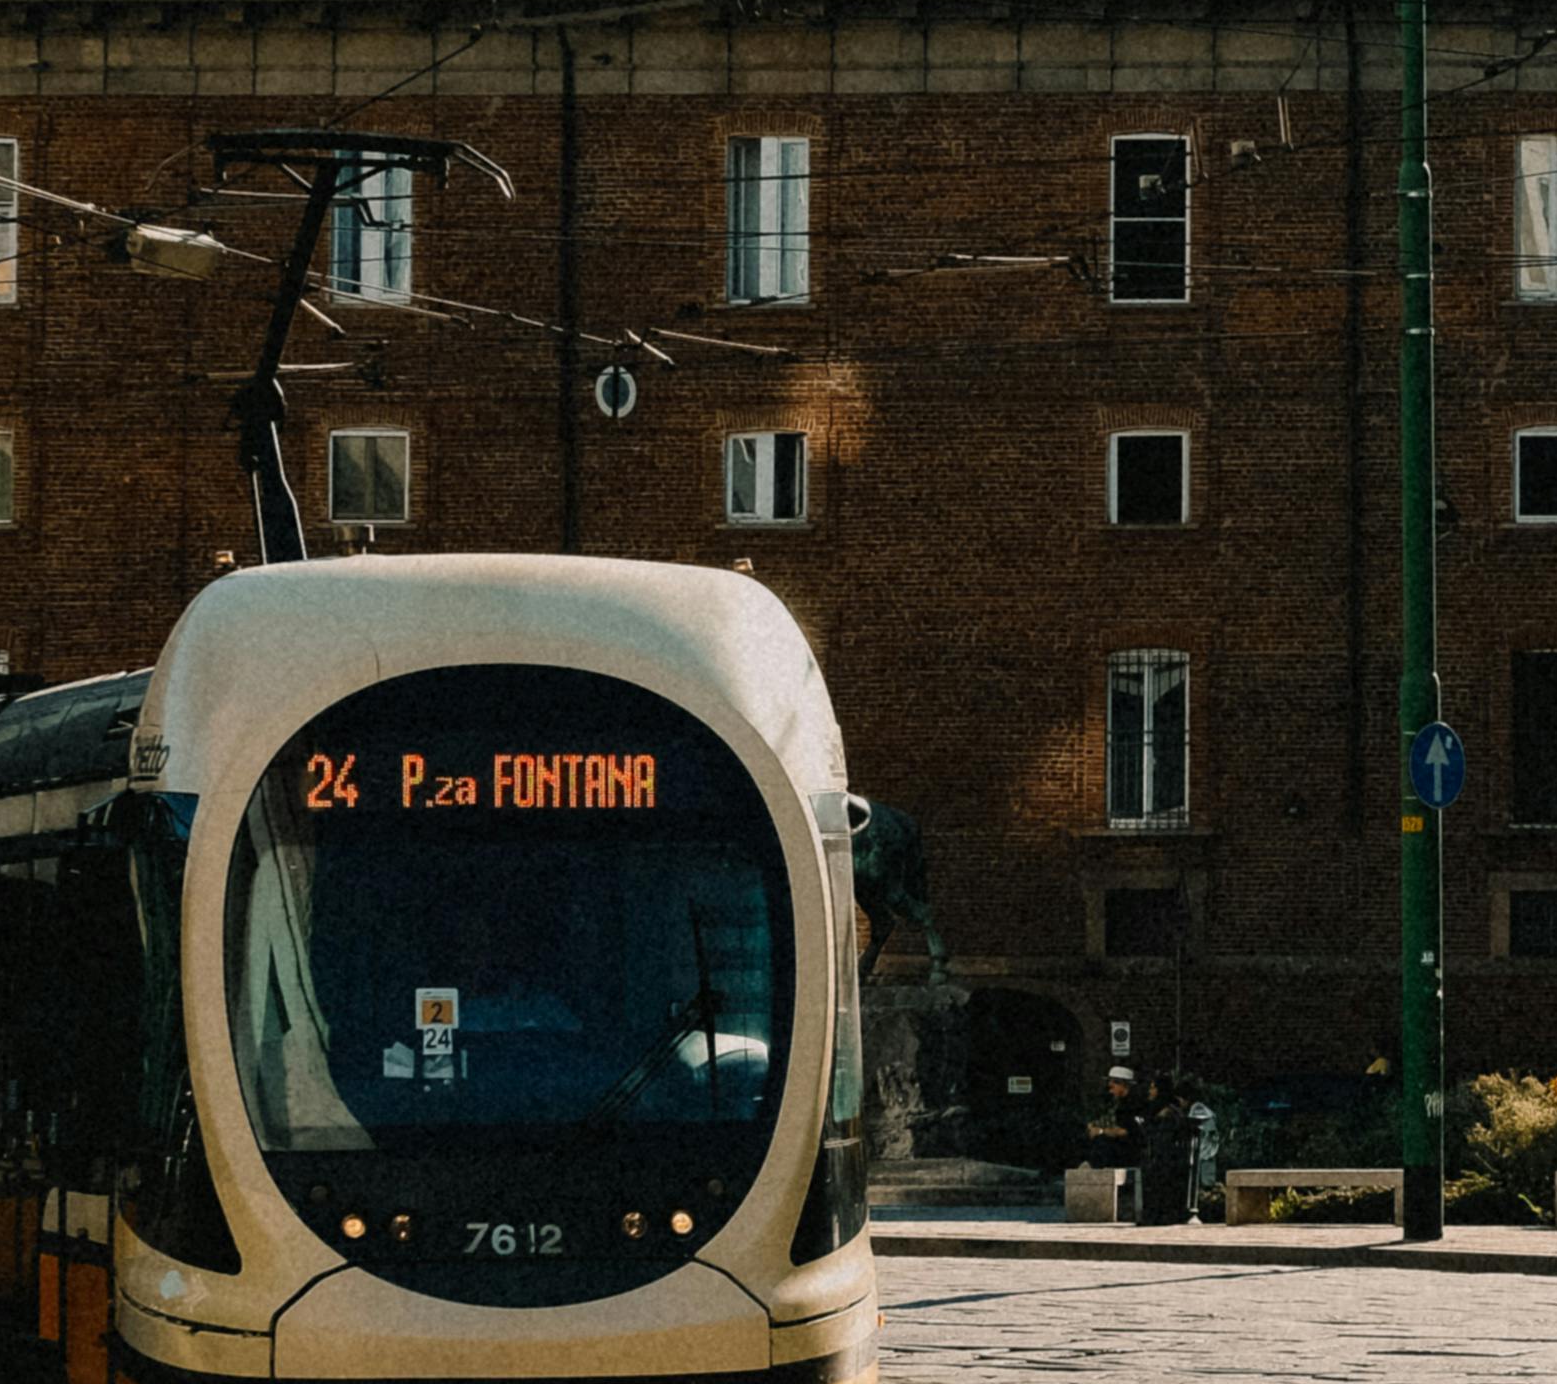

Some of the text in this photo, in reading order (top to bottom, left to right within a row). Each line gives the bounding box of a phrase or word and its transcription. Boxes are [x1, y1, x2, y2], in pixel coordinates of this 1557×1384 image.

[307, 754, 656, 808] 24 P.za FONTANA
[430, 1001, 442, 1023] 2
[425, 1028, 451, 1049] 24
[464, 1222, 563, 1255] 7612
